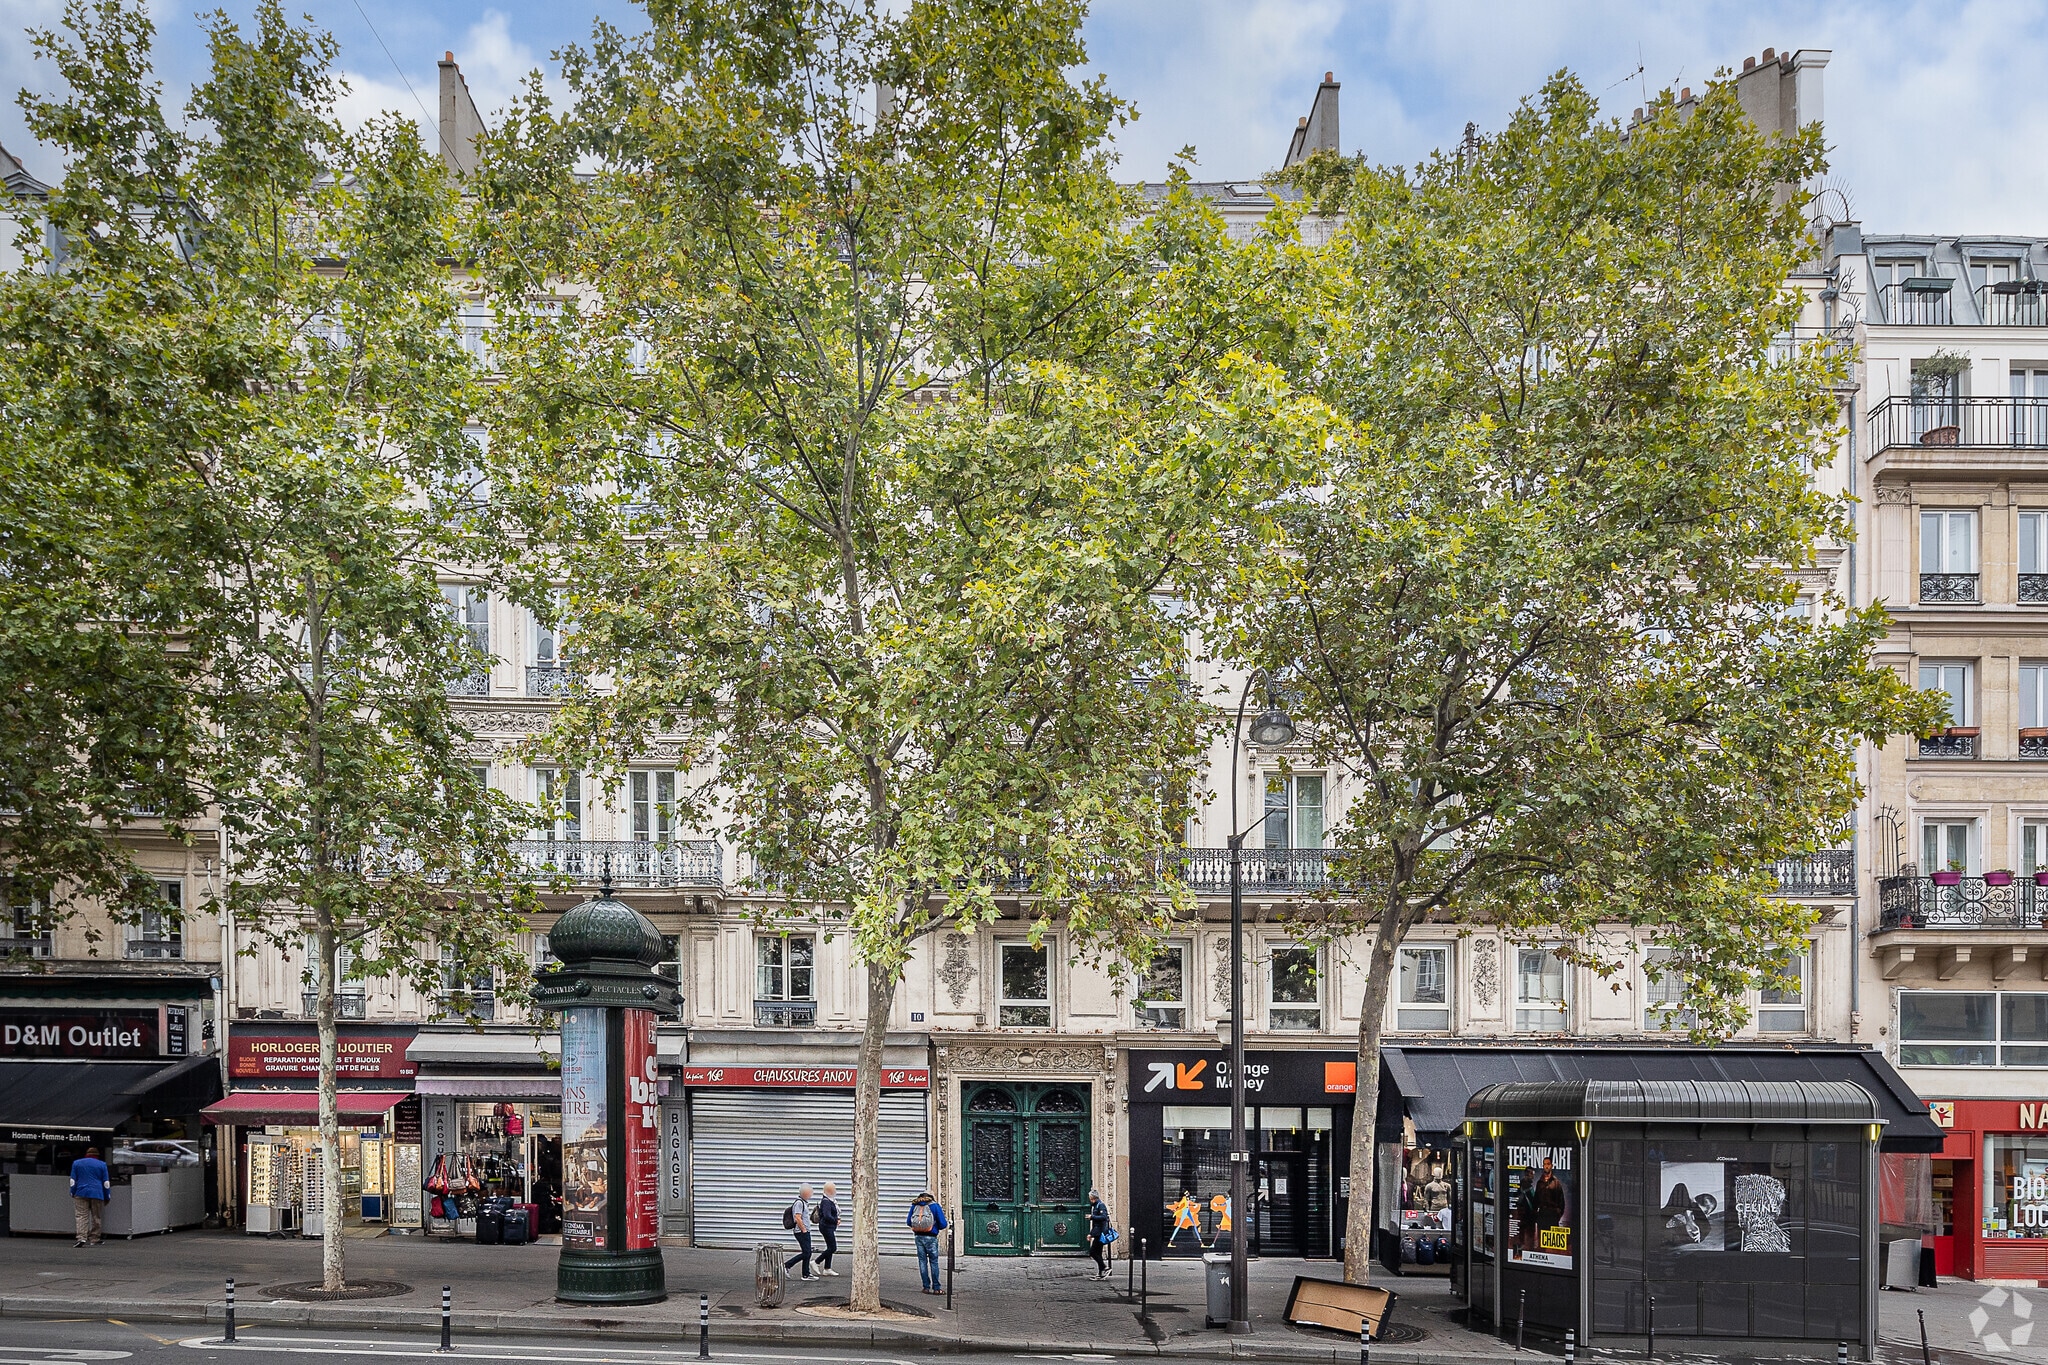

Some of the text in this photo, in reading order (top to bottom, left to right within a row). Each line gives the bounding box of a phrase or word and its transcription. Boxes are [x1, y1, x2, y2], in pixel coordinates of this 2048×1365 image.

[592, 984, 642, 994] SPECTACLES
[913, 1013, 922, 1021] 10
[4, 1025, 141, 1047] D&M Outlet
[338, 1043, 393, 1053] IJOUTIER
[301, 1064, 350, 1072] CHANENT
[1216, 1061, 1270, 1077] Onge
[753, 1069, 820, 1083] CHAUSSURES
[1326, 1083, 1353, 1091] orange
[12, 1131, 91, 1142] Homme Femme Enfant
[671, 1113, 680, 1199] BAGAGES
[1507, 1145, 1573, 1170] TECHNIKART
[2013, 1176, 2046, 1200] BIO
[1735, 1202, 1778, 1213] CELINE
[1541, 1231, 1566, 1249] CHAOS
[1529, 1253, 1549, 1261] ATHENA
